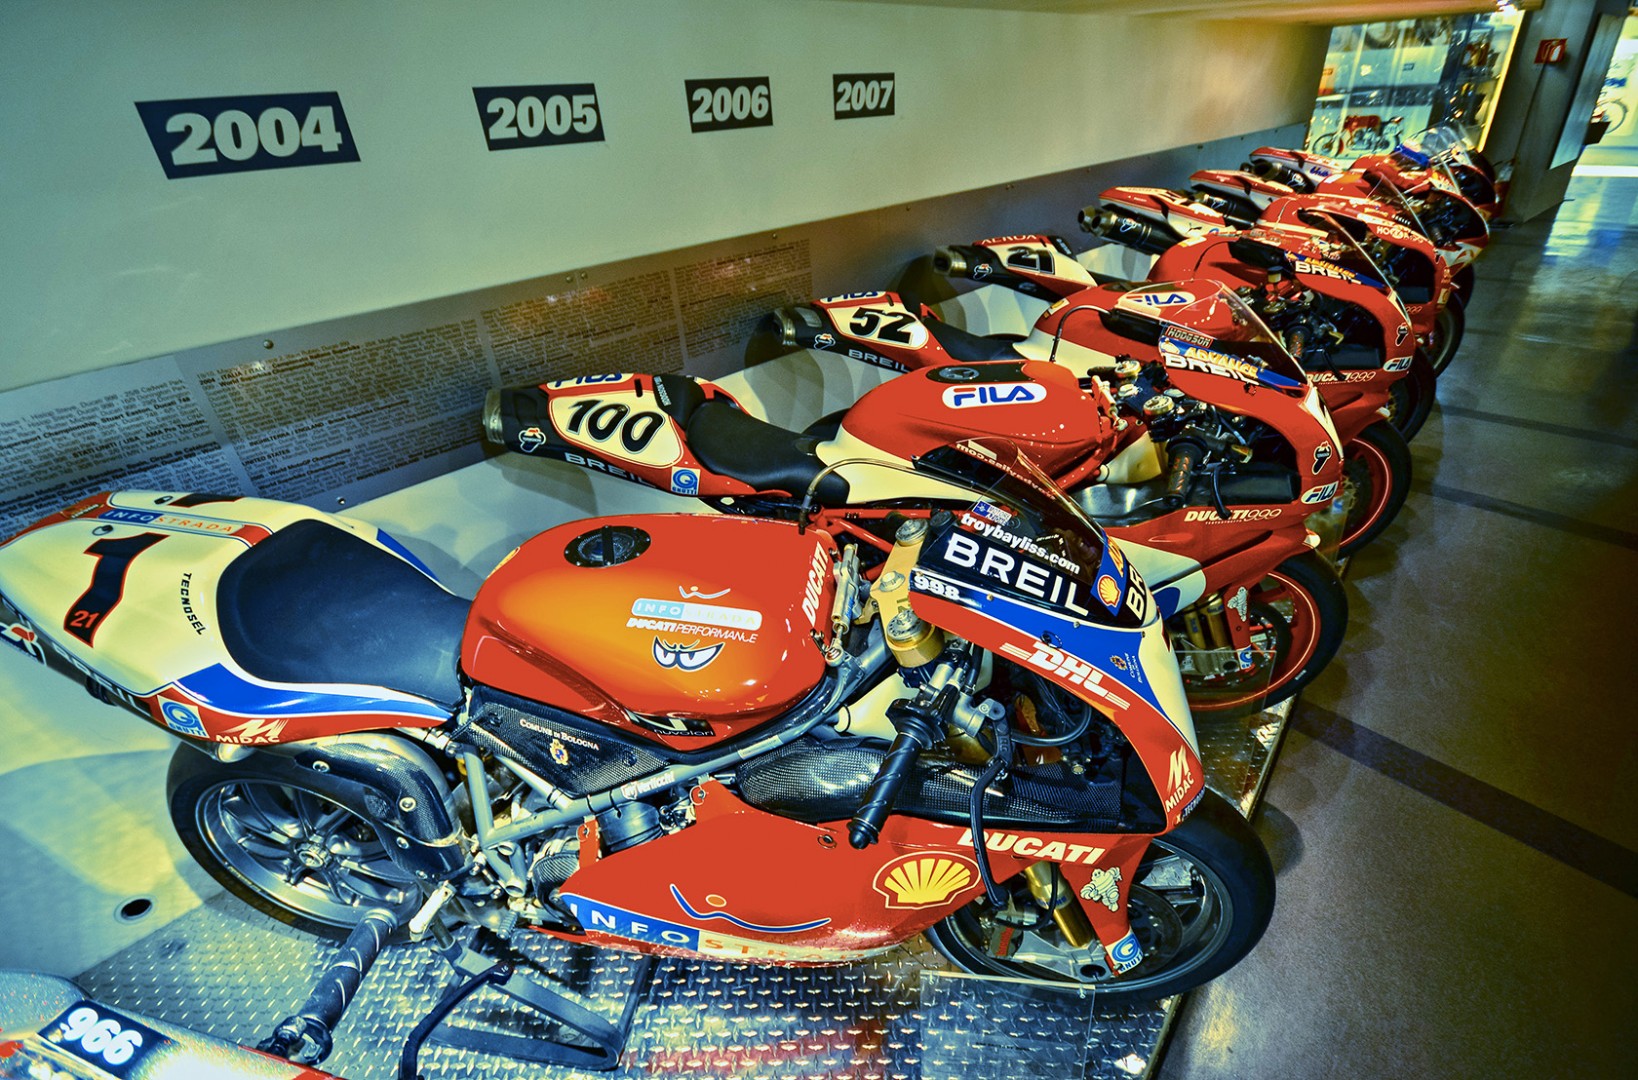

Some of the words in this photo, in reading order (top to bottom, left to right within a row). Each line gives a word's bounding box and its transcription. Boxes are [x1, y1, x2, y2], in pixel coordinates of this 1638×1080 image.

[692, 85, 769, 123] 2006
[836, 80, 894, 111] 2007
[487, 94, 597, 139] 2005
[165, 105, 343, 166] 2004
[1007, 246, 1055, 275] 21
[1126, 292, 1189, 306] FILA
[850, 307, 918, 344] 52
[1168, 328, 1211, 347] HODGSON
[848, 348, 911, 373] BREIL
[1163, 353, 1260, 385] BREIL
[1184, 347, 1259, 379] ADVANCE
[1387, 358, 1410, 370] FILA
[953, 385, 1035, 406] FILA
[566, 399, 665, 453] 100
[565, 452, 657, 488] BREIL
[1307, 484, 1337, 502] FILA
[1184, 510, 1249, 522] DUCTI
[960, 512, 1082, 575] troybayliss.com
[64, 532, 170, 648] 1
[802, 541, 829, 628] DUCATI
[912, 574, 961, 602] 998
[943, 532, 1090, 618] BREIL
[70, 610, 99, 628] 21
[180, 572, 206, 636] TECNOSEL
[1026, 641, 1112, 696] DHL
[215, 734, 281, 744] MIDAC
[653, 728, 715, 737] nuvolari
[1164, 771, 1195, 813] MIDAC
[957, 829, 1105, 865] DUCATI
